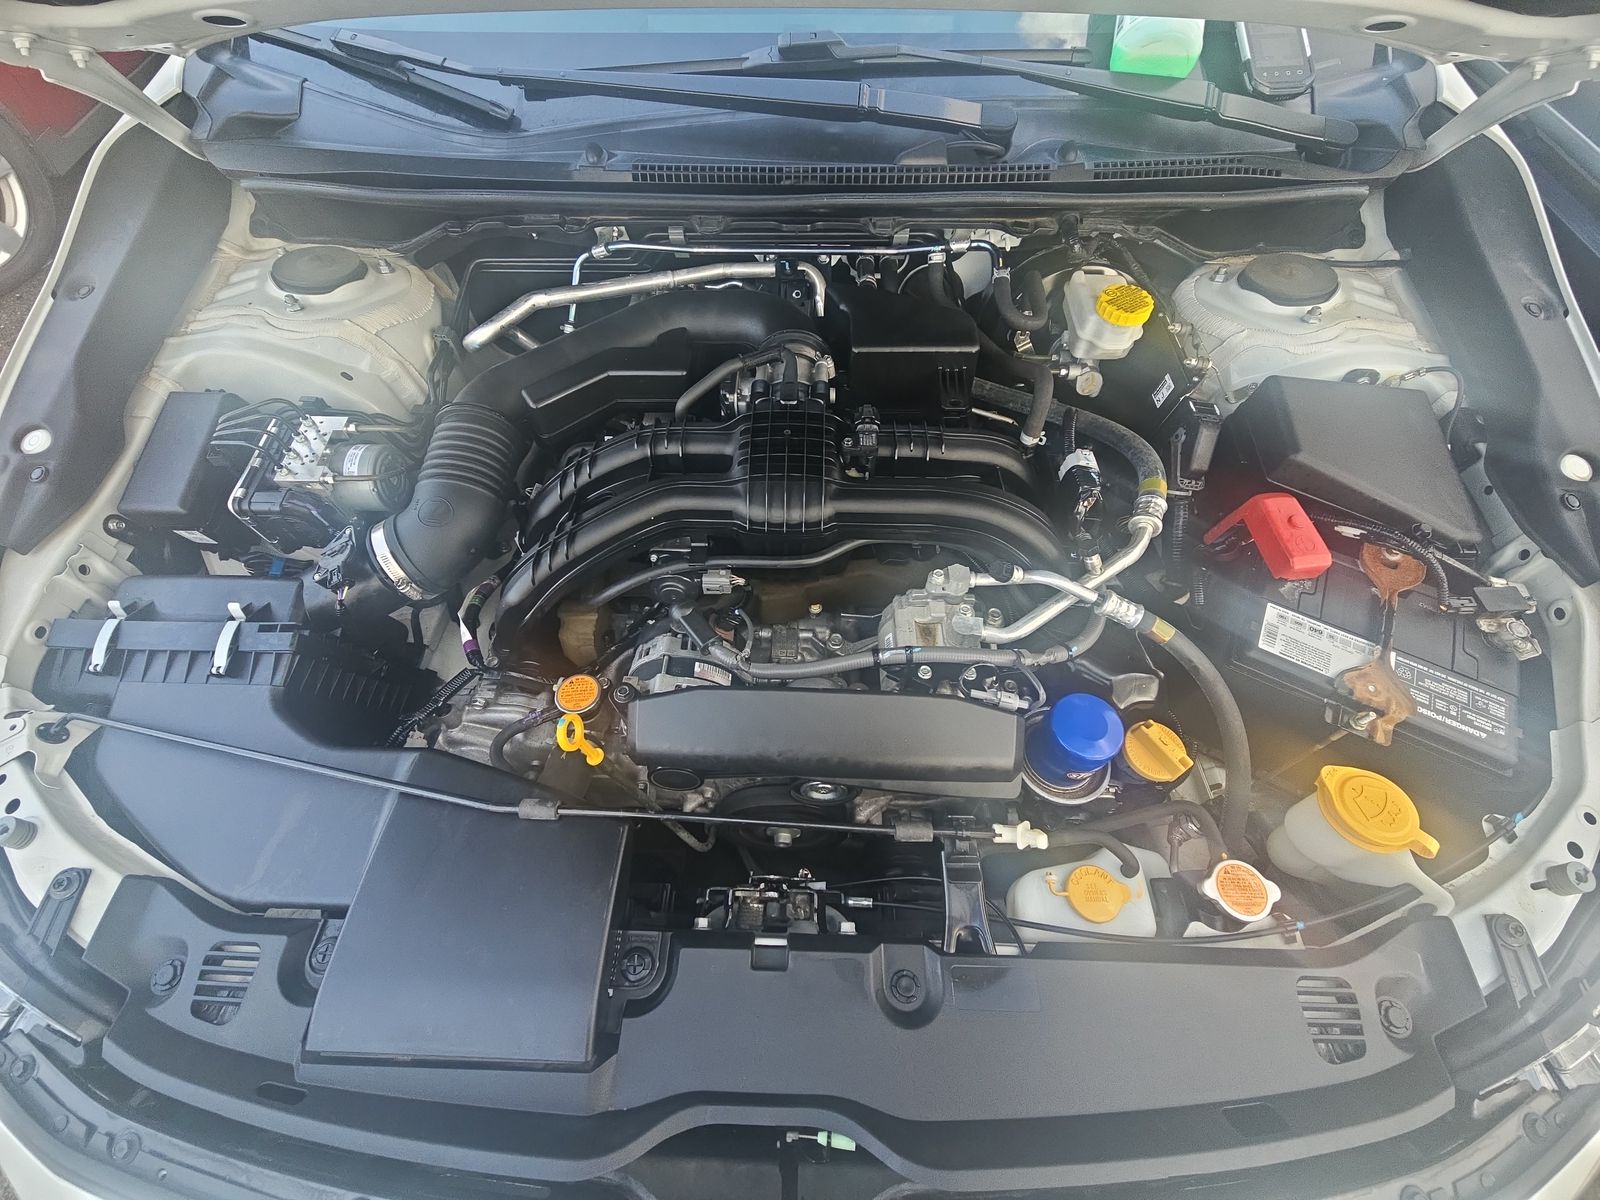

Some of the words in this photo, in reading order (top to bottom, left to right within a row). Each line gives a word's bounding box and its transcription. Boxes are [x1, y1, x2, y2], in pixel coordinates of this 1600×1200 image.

[1309, 625, 1323, 636] 640
[1417, 705, 1480, 736] DANGER/POISO
[1071, 867, 1113, 886] COOLANT
